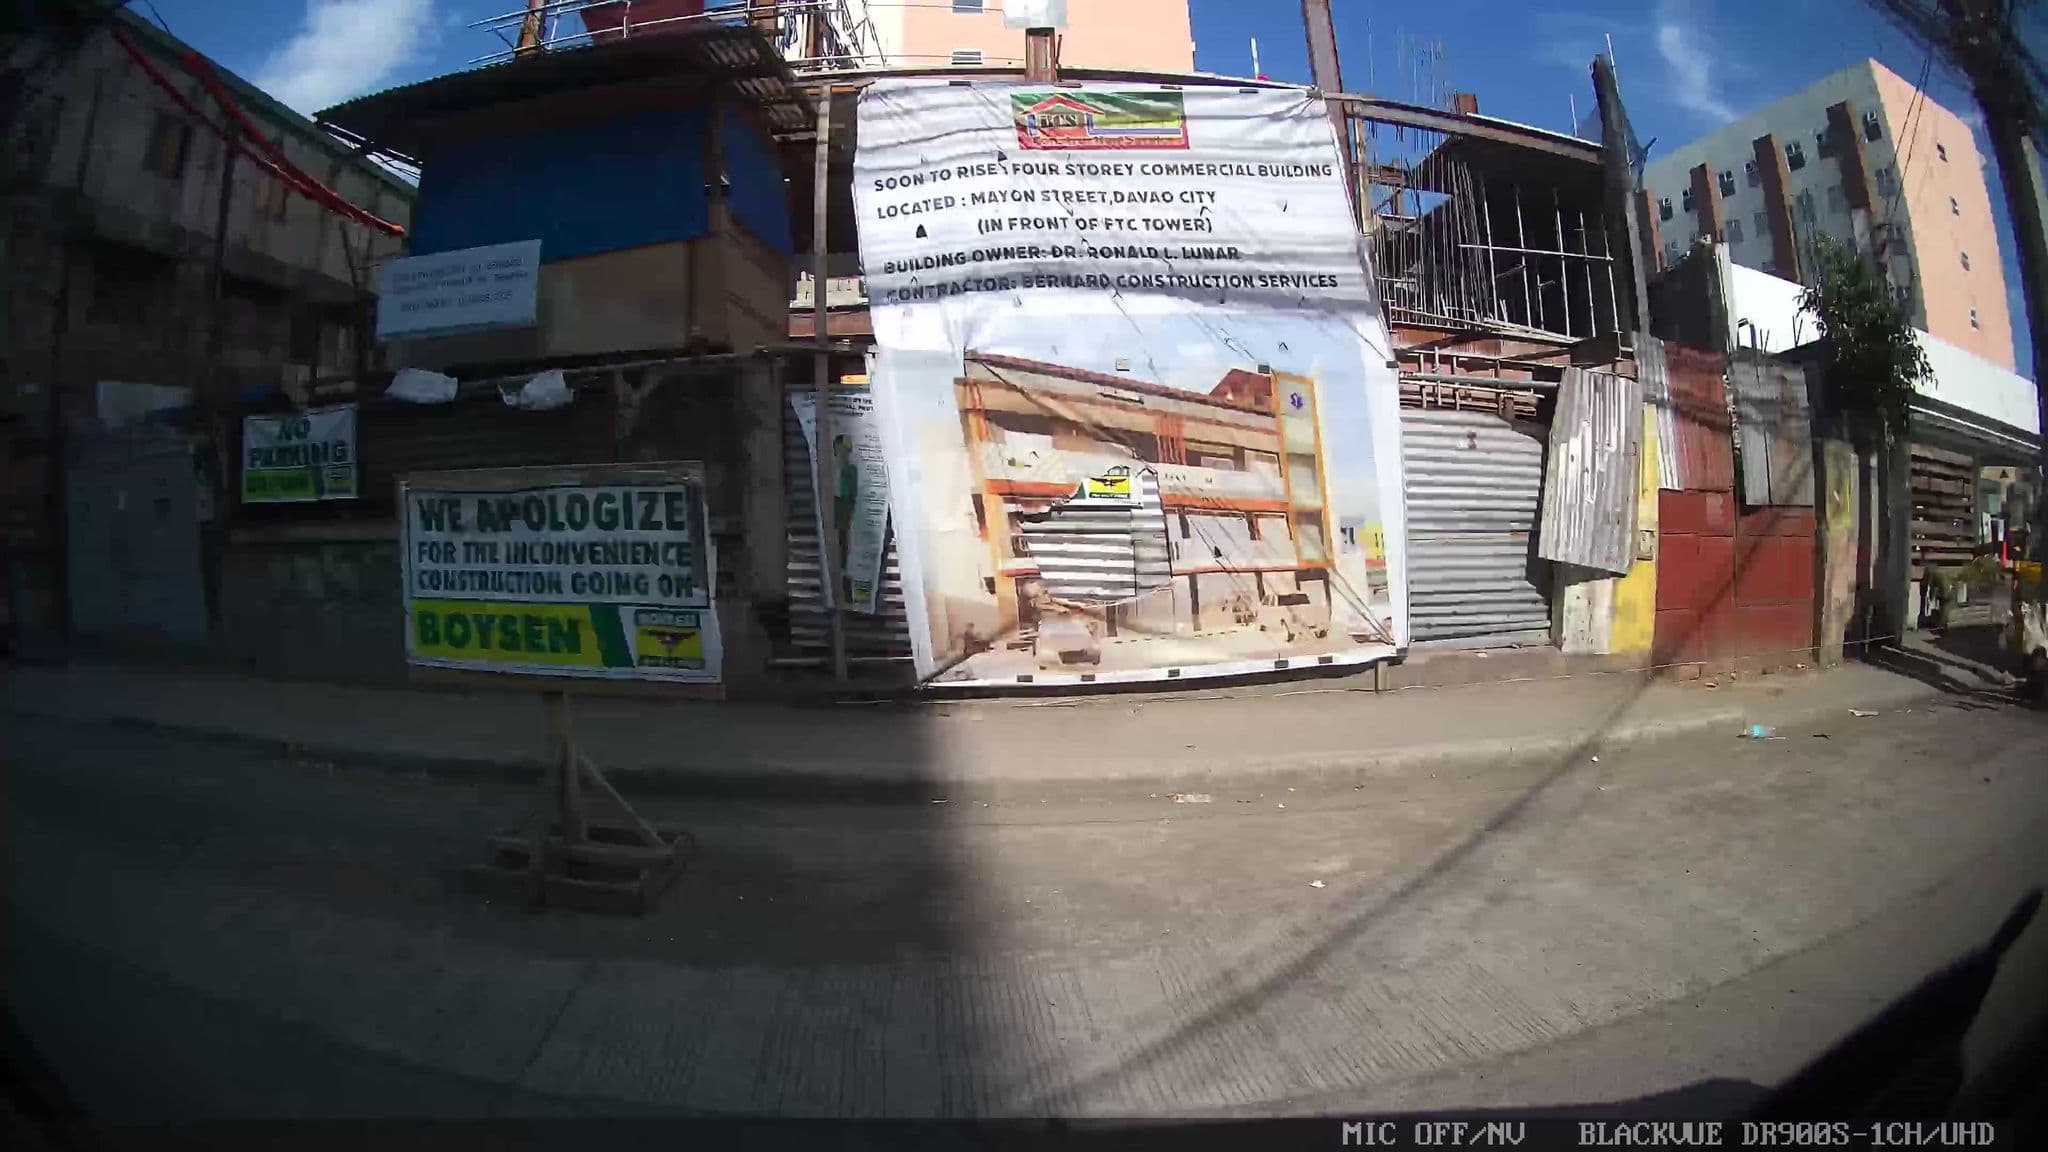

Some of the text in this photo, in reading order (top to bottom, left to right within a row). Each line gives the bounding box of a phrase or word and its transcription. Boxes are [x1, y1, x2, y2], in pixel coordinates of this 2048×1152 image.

[874, 173, 925, 192] SOON
[929, 169, 951, 183] TO
[1012, 163, 1060, 176] FOUR
[1065, 163, 1134, 176] STOREY
[1140, 163, 1255, 177] COMMERCIAL
[1257, 164, 1332, 178] BUILDING
[877, 195, 956, 219] LOCATED
[970, 190, 1035, 206] MAYON
[1179, 190, 1217, 203] CITY
[977, 217, 1213, 235] (IN FRONT OF FTC TOWER)
[884, 245, 1241, 274] BUILDING OWNER: DR. RONALD L. LUNAR
[887, 273, 1338, 304] CONTRACTOR: BERNARD CONSTRUCTION SERVICES
[279, 419, 311, 440] NO
[248, 440, 348, 468] PARKING
[417, 491, 686, 532] WE APOLOGIZE
[417, 541, 692, 566] FOR THE INCONVENIENCE
[417, 569, 694, 599] CONSTRUCTION GOING ON
[418, 610, 582, 654] BOYSEN
